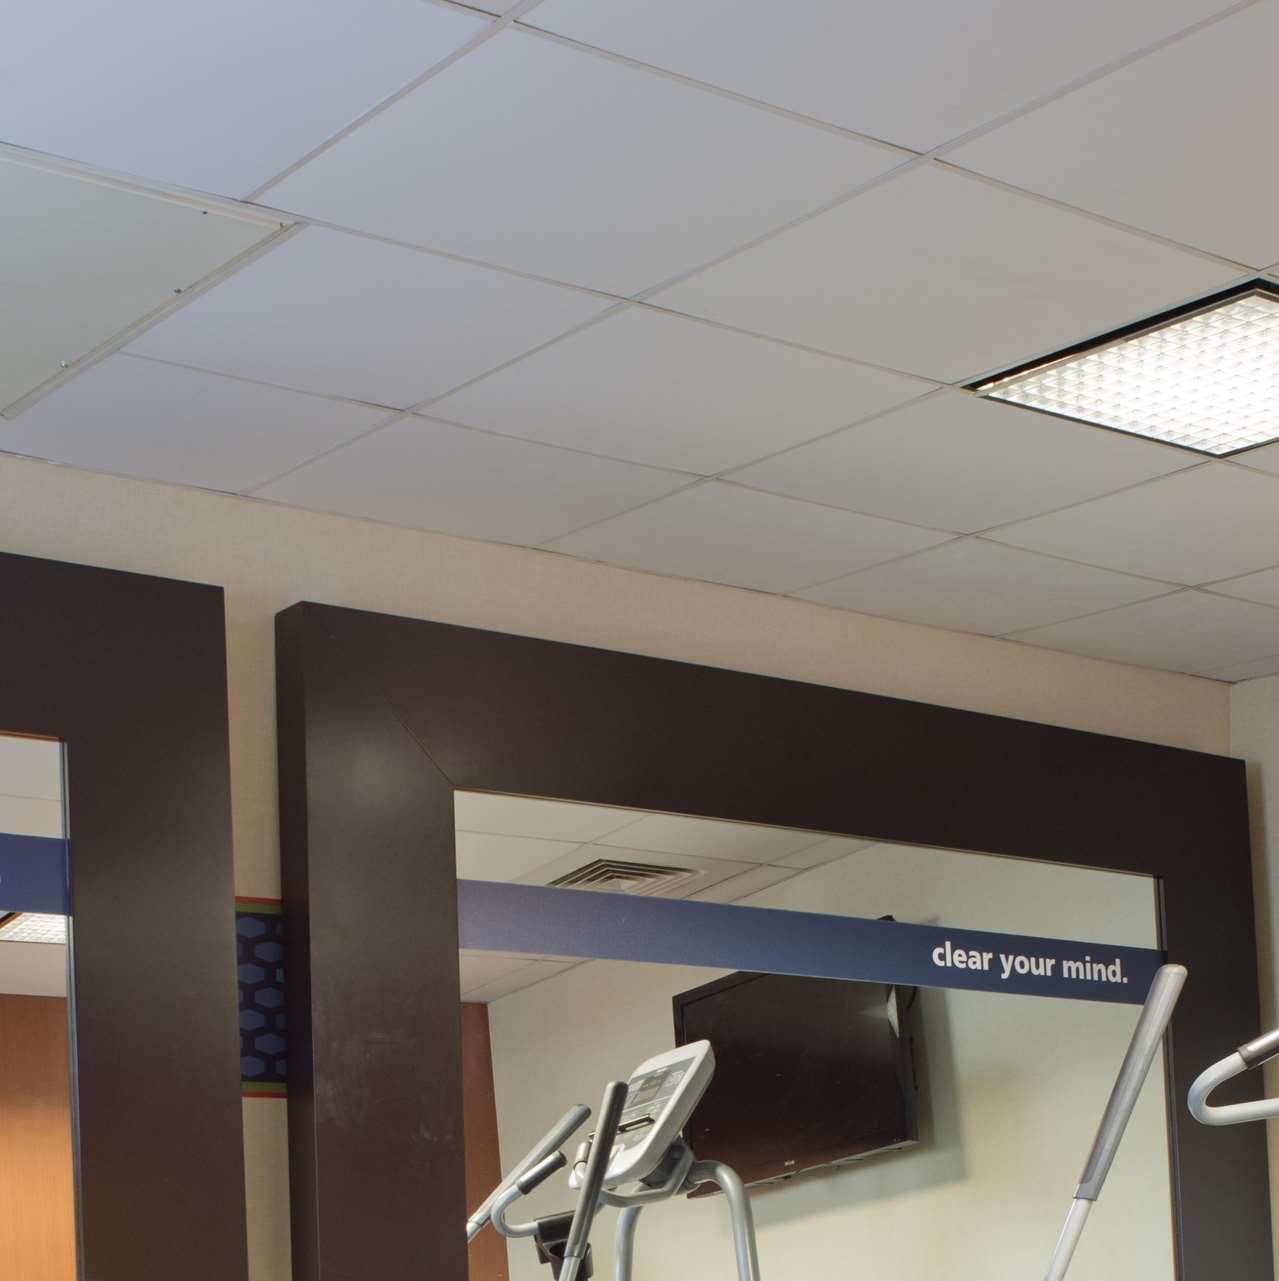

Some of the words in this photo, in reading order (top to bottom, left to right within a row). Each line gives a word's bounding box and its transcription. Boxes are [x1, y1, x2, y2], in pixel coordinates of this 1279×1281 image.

[932, 941, 993, 970] clear
[999, 953, 1056, 980] your
[1063, 956, 1128, 984] mind.
